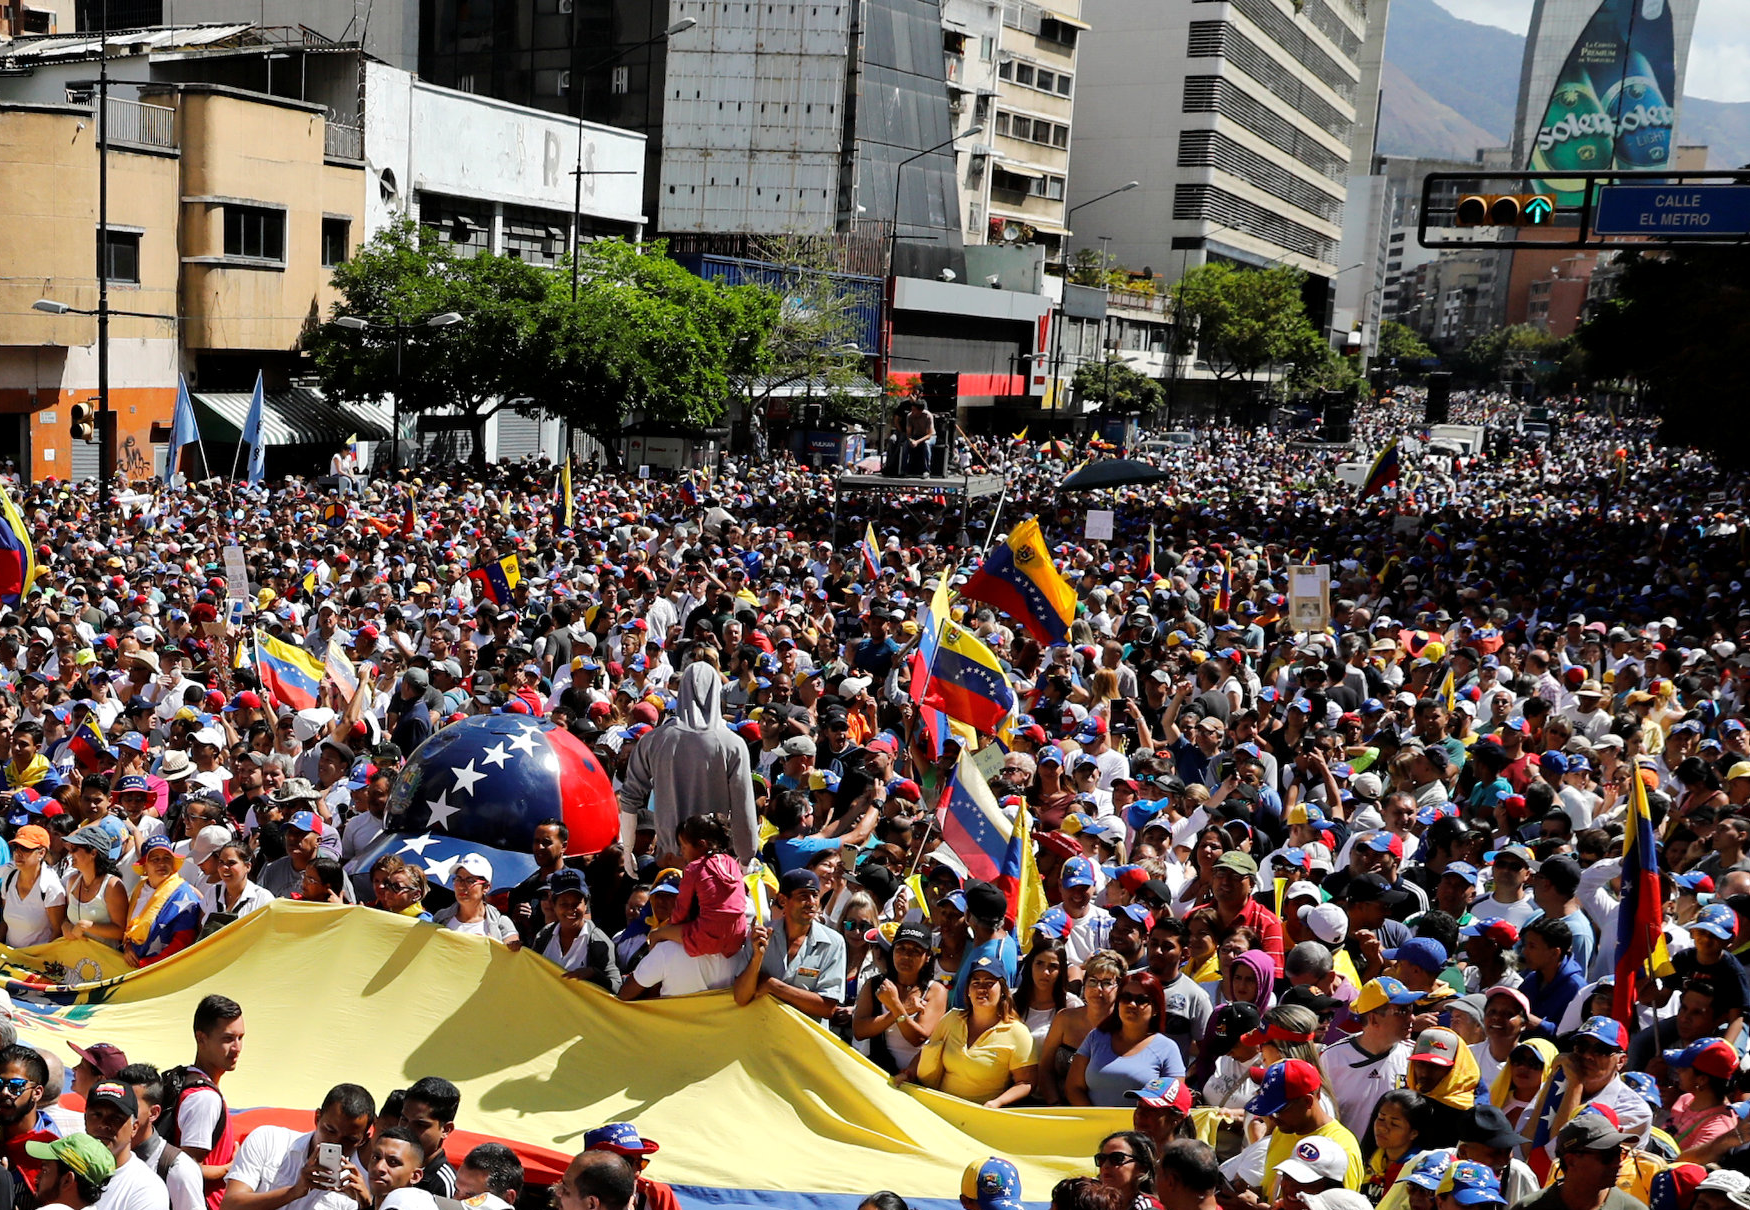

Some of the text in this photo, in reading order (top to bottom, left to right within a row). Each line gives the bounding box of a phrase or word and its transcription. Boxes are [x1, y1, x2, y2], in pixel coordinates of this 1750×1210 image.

[1655, 195, 1702, 207] CALLE
[1639, 213, 1711, 226] EL METRO
[1302, 1144, 1317, 1158] T
